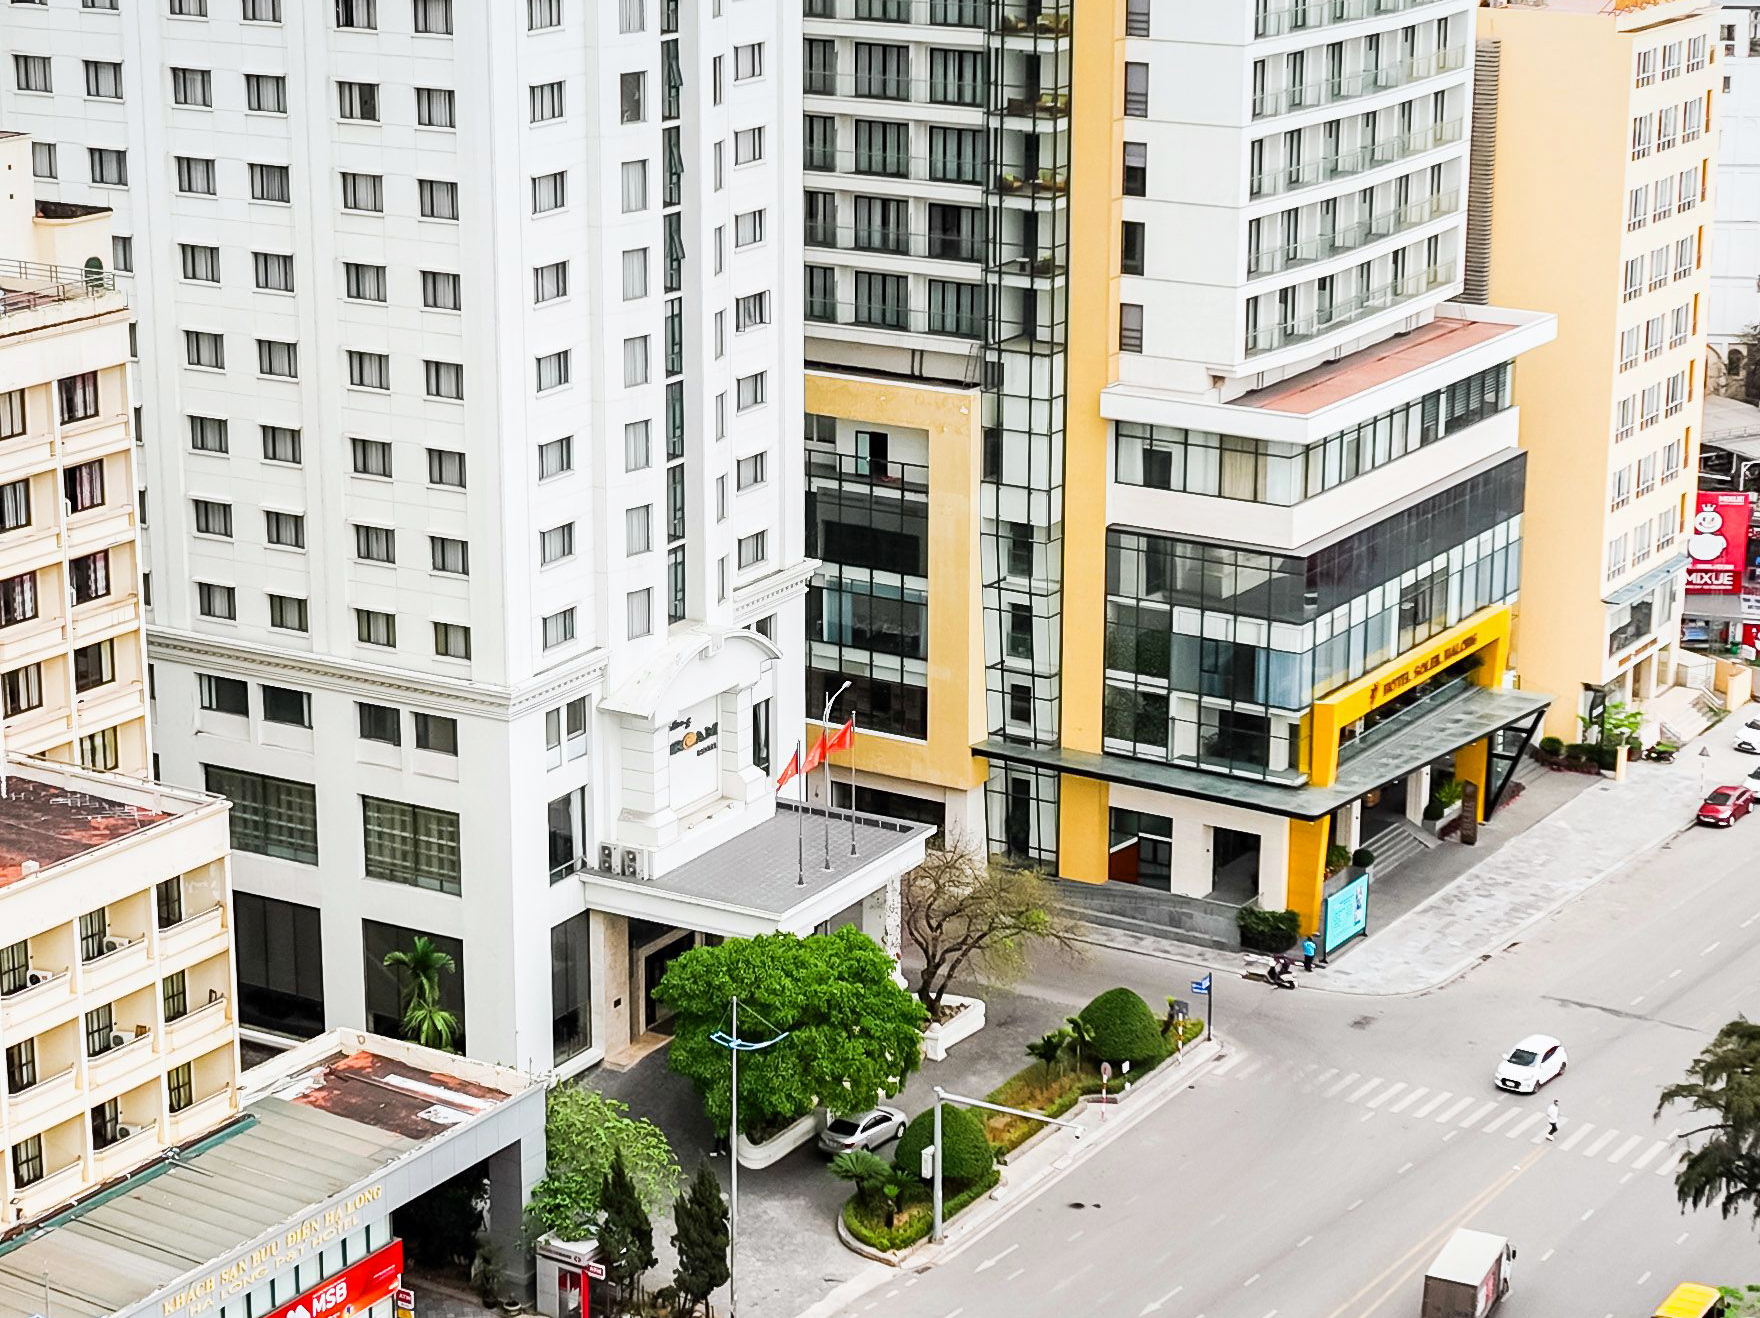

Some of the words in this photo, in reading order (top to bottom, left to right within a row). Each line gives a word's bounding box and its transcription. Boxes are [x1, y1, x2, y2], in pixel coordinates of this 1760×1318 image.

[1685, 572, 1733, 585] MIXUE
[162, 1276, 215, 1316] KHÁCH
[346, 1184, 382, 1214] LONG
[220, 1267, 269, 1301] LONG
[312, 1216, 359, 1249] HOTEL
[312, 1281, 347, 1317] MSB
